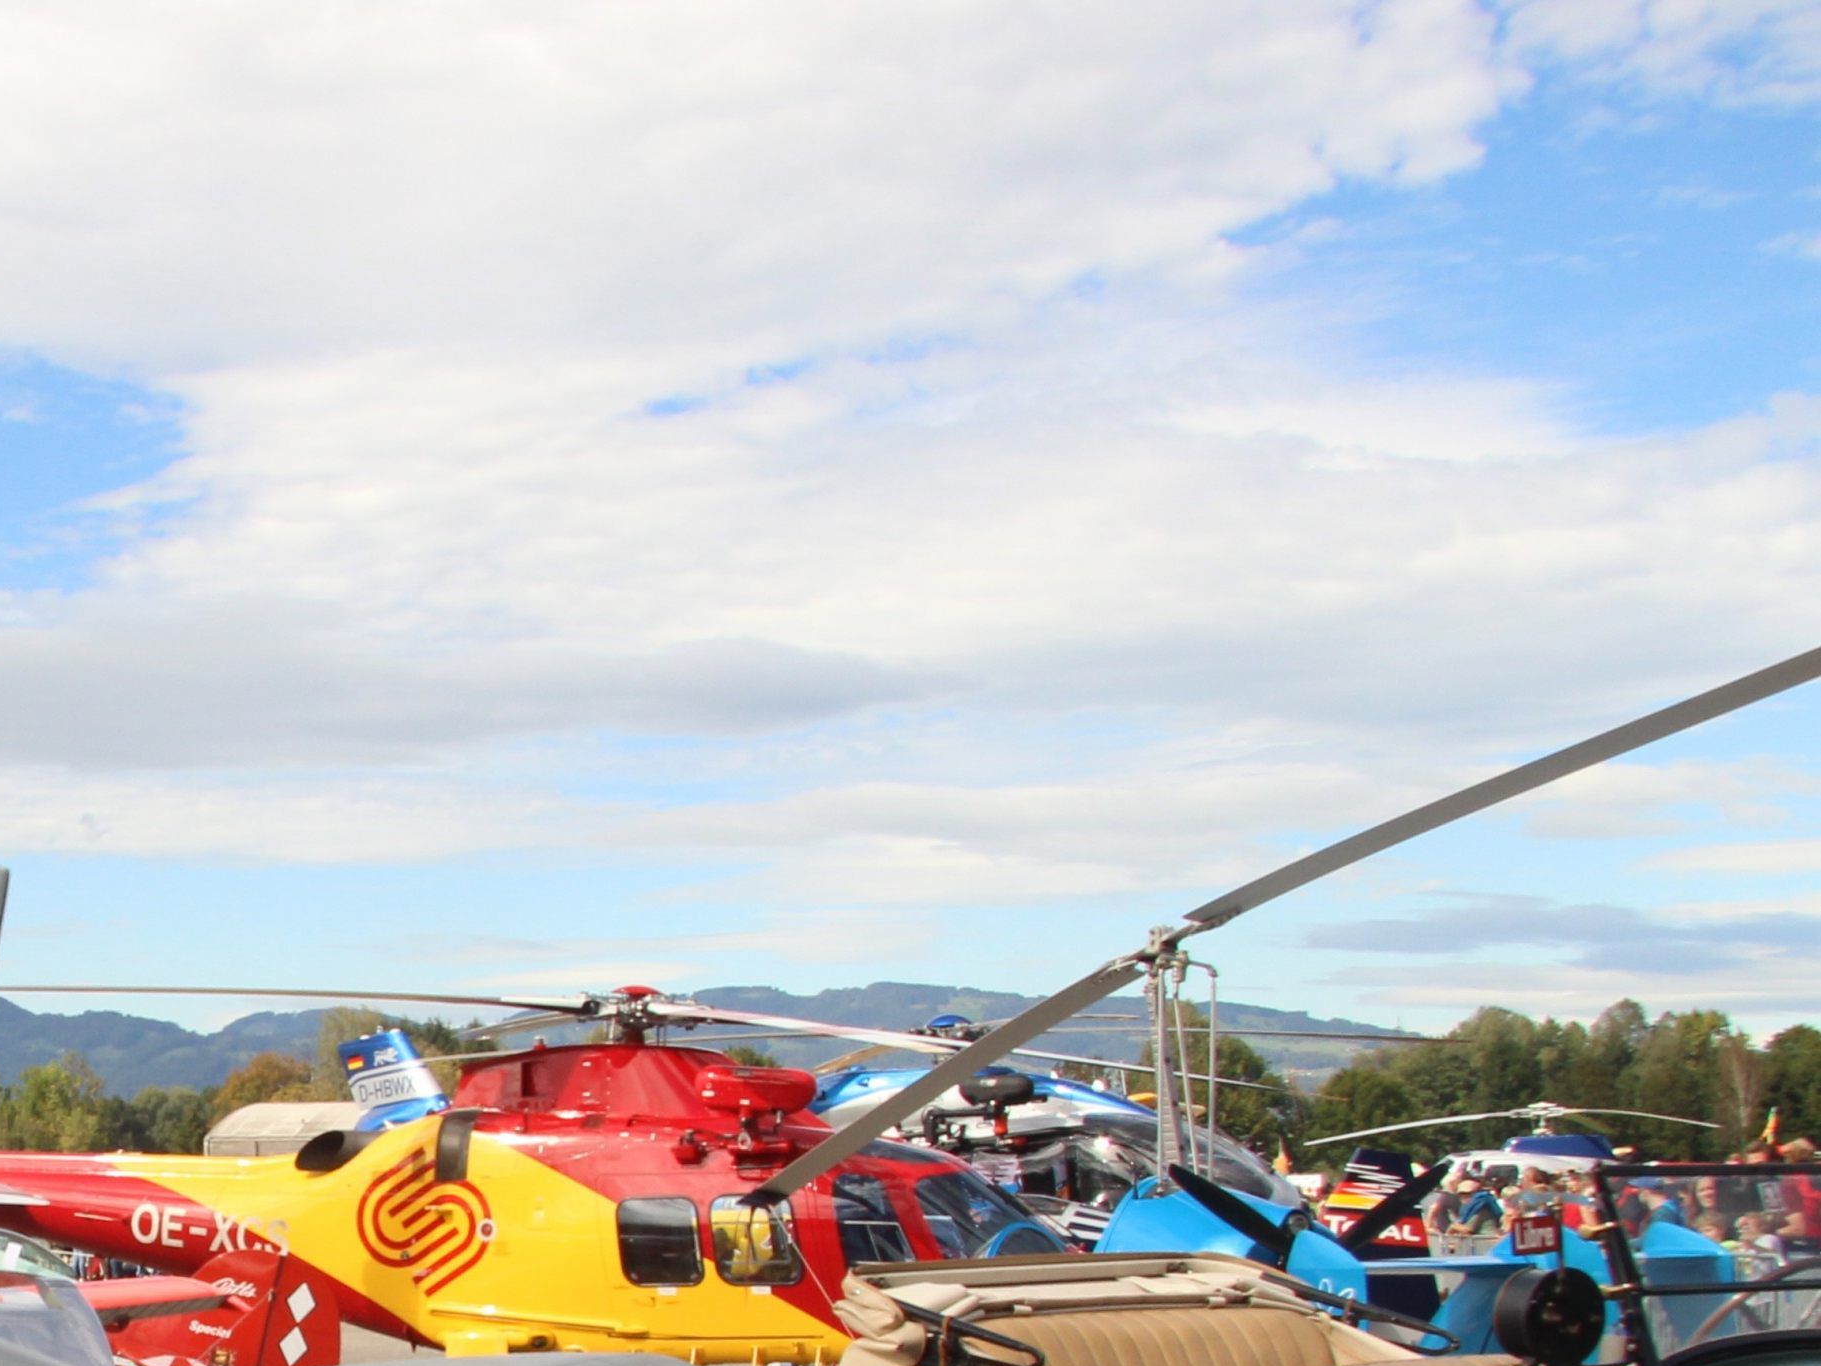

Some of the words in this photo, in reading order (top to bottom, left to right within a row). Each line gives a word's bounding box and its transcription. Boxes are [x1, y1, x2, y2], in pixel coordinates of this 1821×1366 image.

[358, 1076, 416, 1103] D-HBWX
[131, 1202, 289, 1257] OE-XCS
[1323, 1214, 1421, 1242] TAL
[188, 1319, 233, 1339] Special
